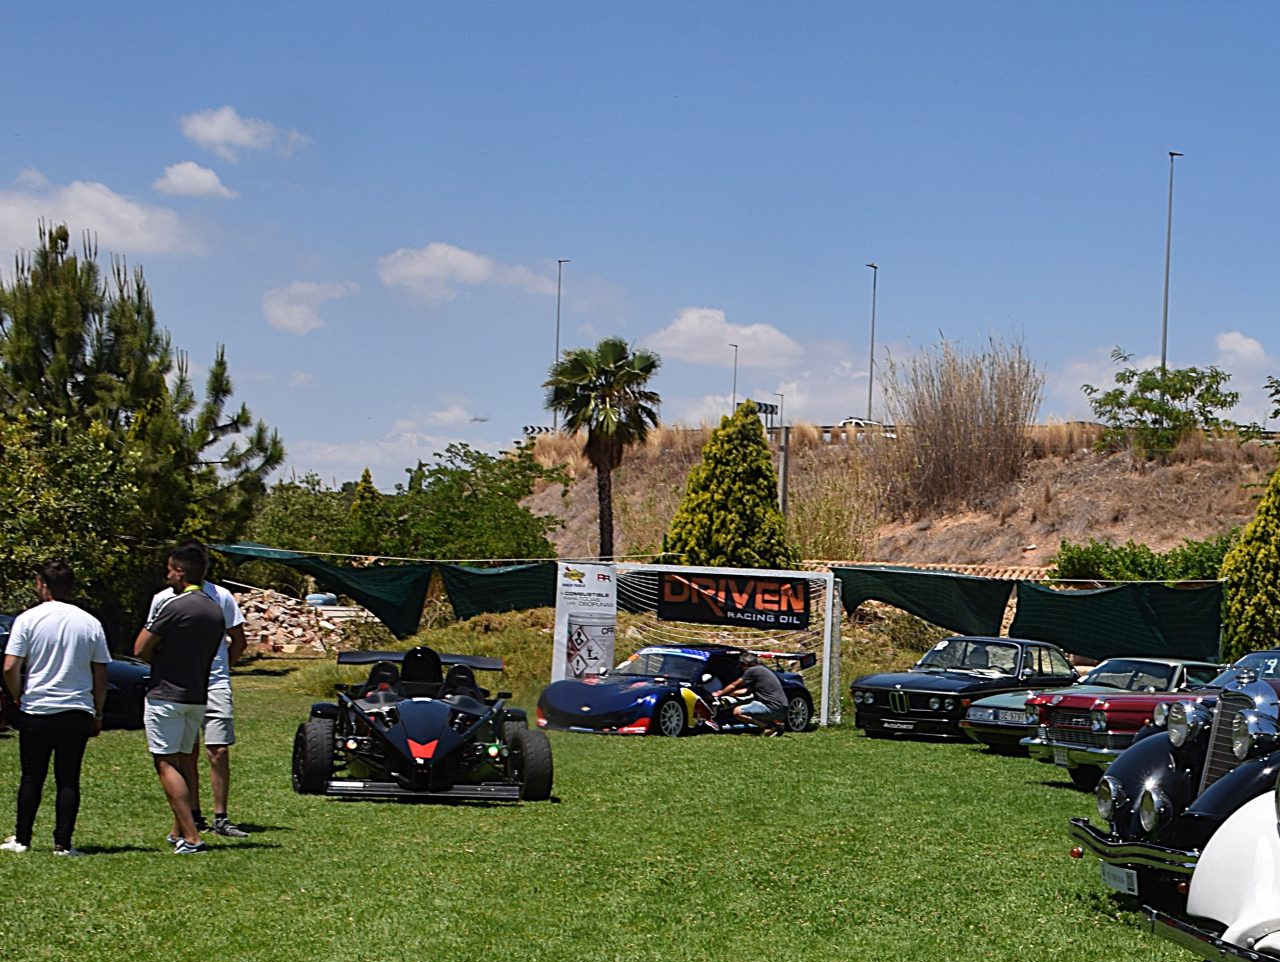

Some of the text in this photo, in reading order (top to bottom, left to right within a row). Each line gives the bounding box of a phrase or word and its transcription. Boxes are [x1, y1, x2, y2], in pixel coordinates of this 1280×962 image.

[663, 574, 805, 617] DRIVEN
[727, 611, 801, 625] RACING OIL
